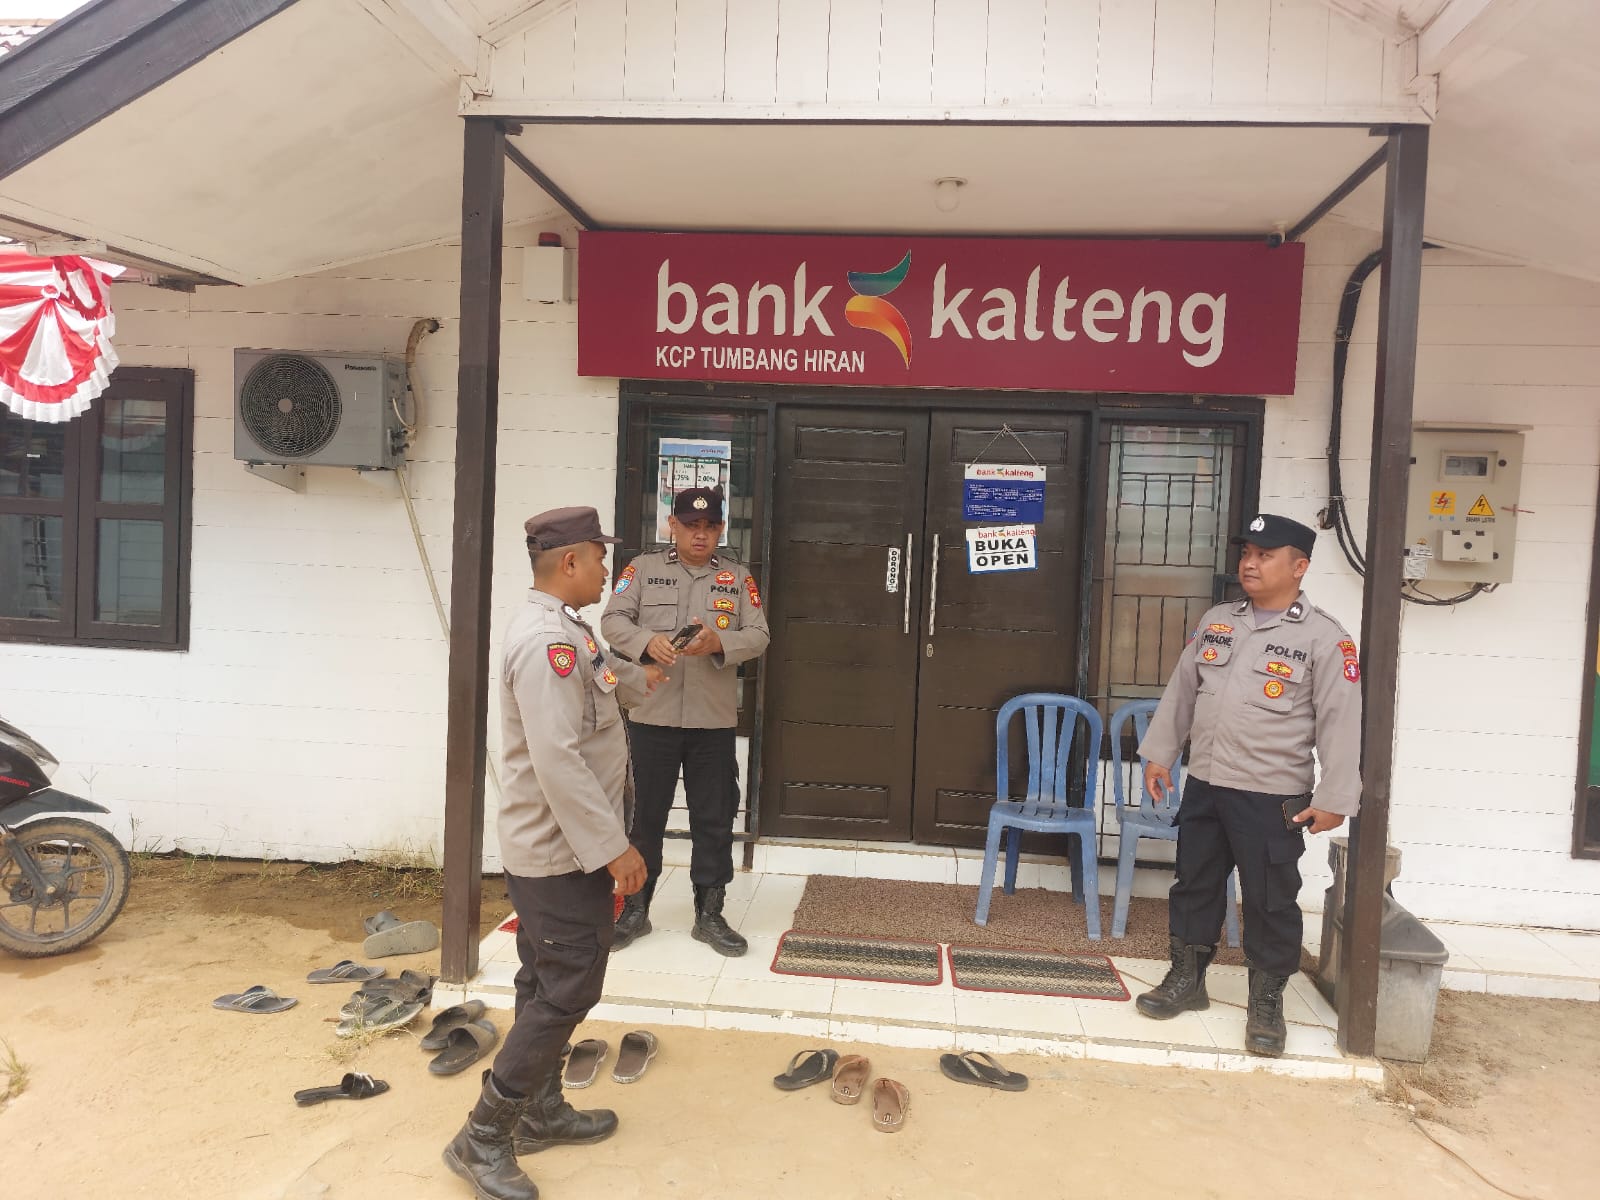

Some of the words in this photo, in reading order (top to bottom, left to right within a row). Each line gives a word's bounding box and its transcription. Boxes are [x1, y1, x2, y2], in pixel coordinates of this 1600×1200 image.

[655, 259, 836, 337] bank
[929, 263, 1227, 368] kalteng
[656, 345, 696, 369] KCP
[700, 346, 798, 372] TUMBANG
[804, 349, 865, 374] HIRAN
[976, 468, 996, 476] bank
[1004, 468, 1034, 478] kalteng
[977, 529, 998, 539] bank
[1006, 527, 1036, 537] kalteng
[974, 537, 1027, 552] BUKA
[976, 553, 1029, 567] OPEN
[710, 584, 740, 596] POLRI
[1264, 643, 1307, 663] POLRI
